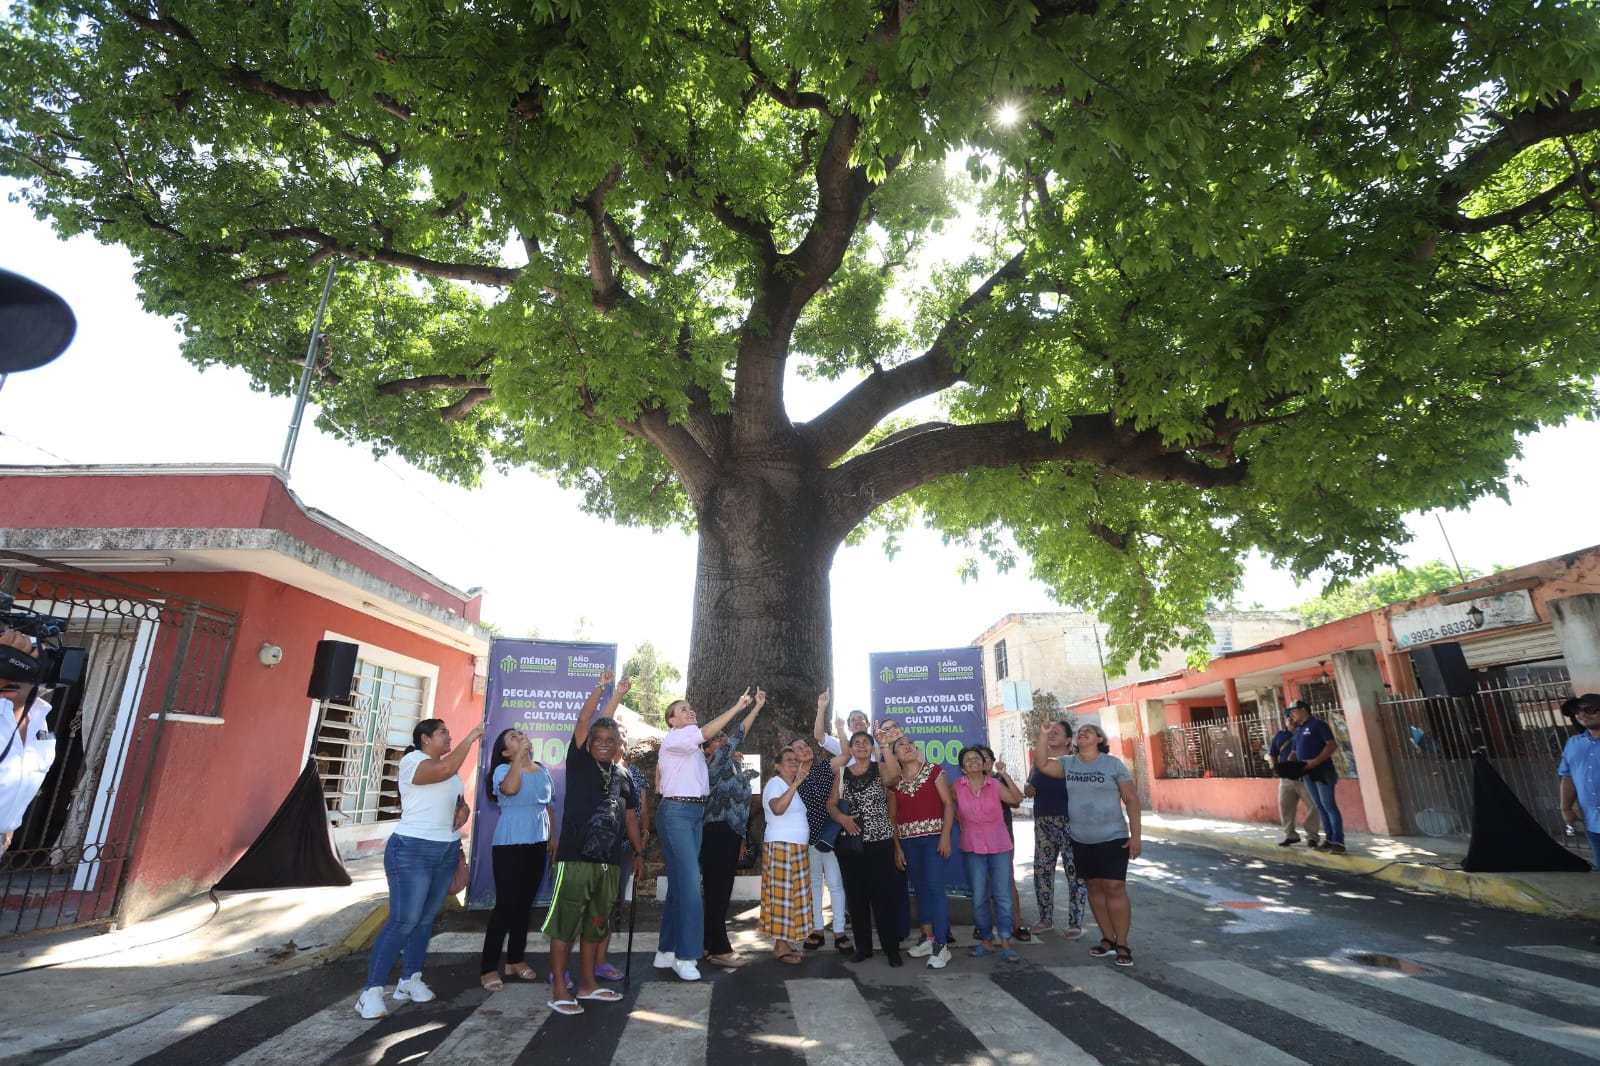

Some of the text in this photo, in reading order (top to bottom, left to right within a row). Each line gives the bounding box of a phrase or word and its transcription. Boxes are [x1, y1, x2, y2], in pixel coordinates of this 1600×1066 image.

[1411, 619, 1474, 643] 9992-68382
[8, 658, 31, 670] SONY
[520, 656, 557, 665] MÉRIDA
[502, 689, 583, 699] DECLARATORIA
[885, 693, 975, 704] DECLARATORIA DEL
[502, 697, 536, 708] ÁRBOL
[538, 702, 563, 710] CON
[885, 704, 974, 714] ÁRBOL CON VALOR
[523, 711, 578, 721] CULTURAL
[905, 715, 954, 724] CULTURAL
[514, 722, 575, 732] PATRIMONI
[532, 738, 568, 766] 10
